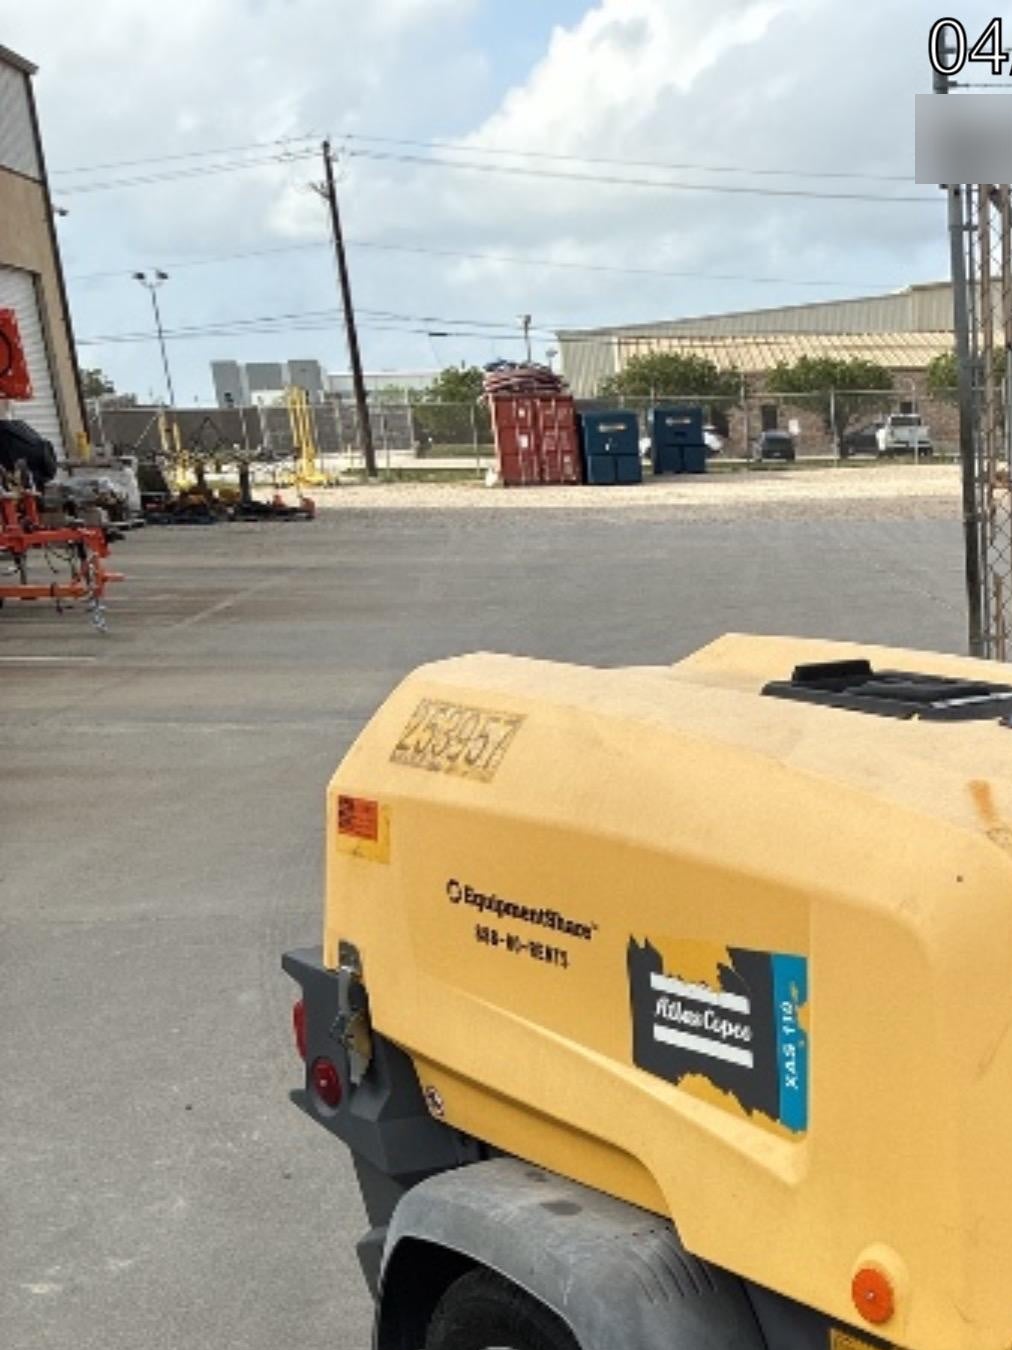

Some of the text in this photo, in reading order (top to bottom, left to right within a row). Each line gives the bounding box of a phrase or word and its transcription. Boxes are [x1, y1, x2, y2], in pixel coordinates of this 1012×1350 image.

[654, 995, 753, 1043] Atlas Copco
[781, 1043, 799, 1090] XAS
